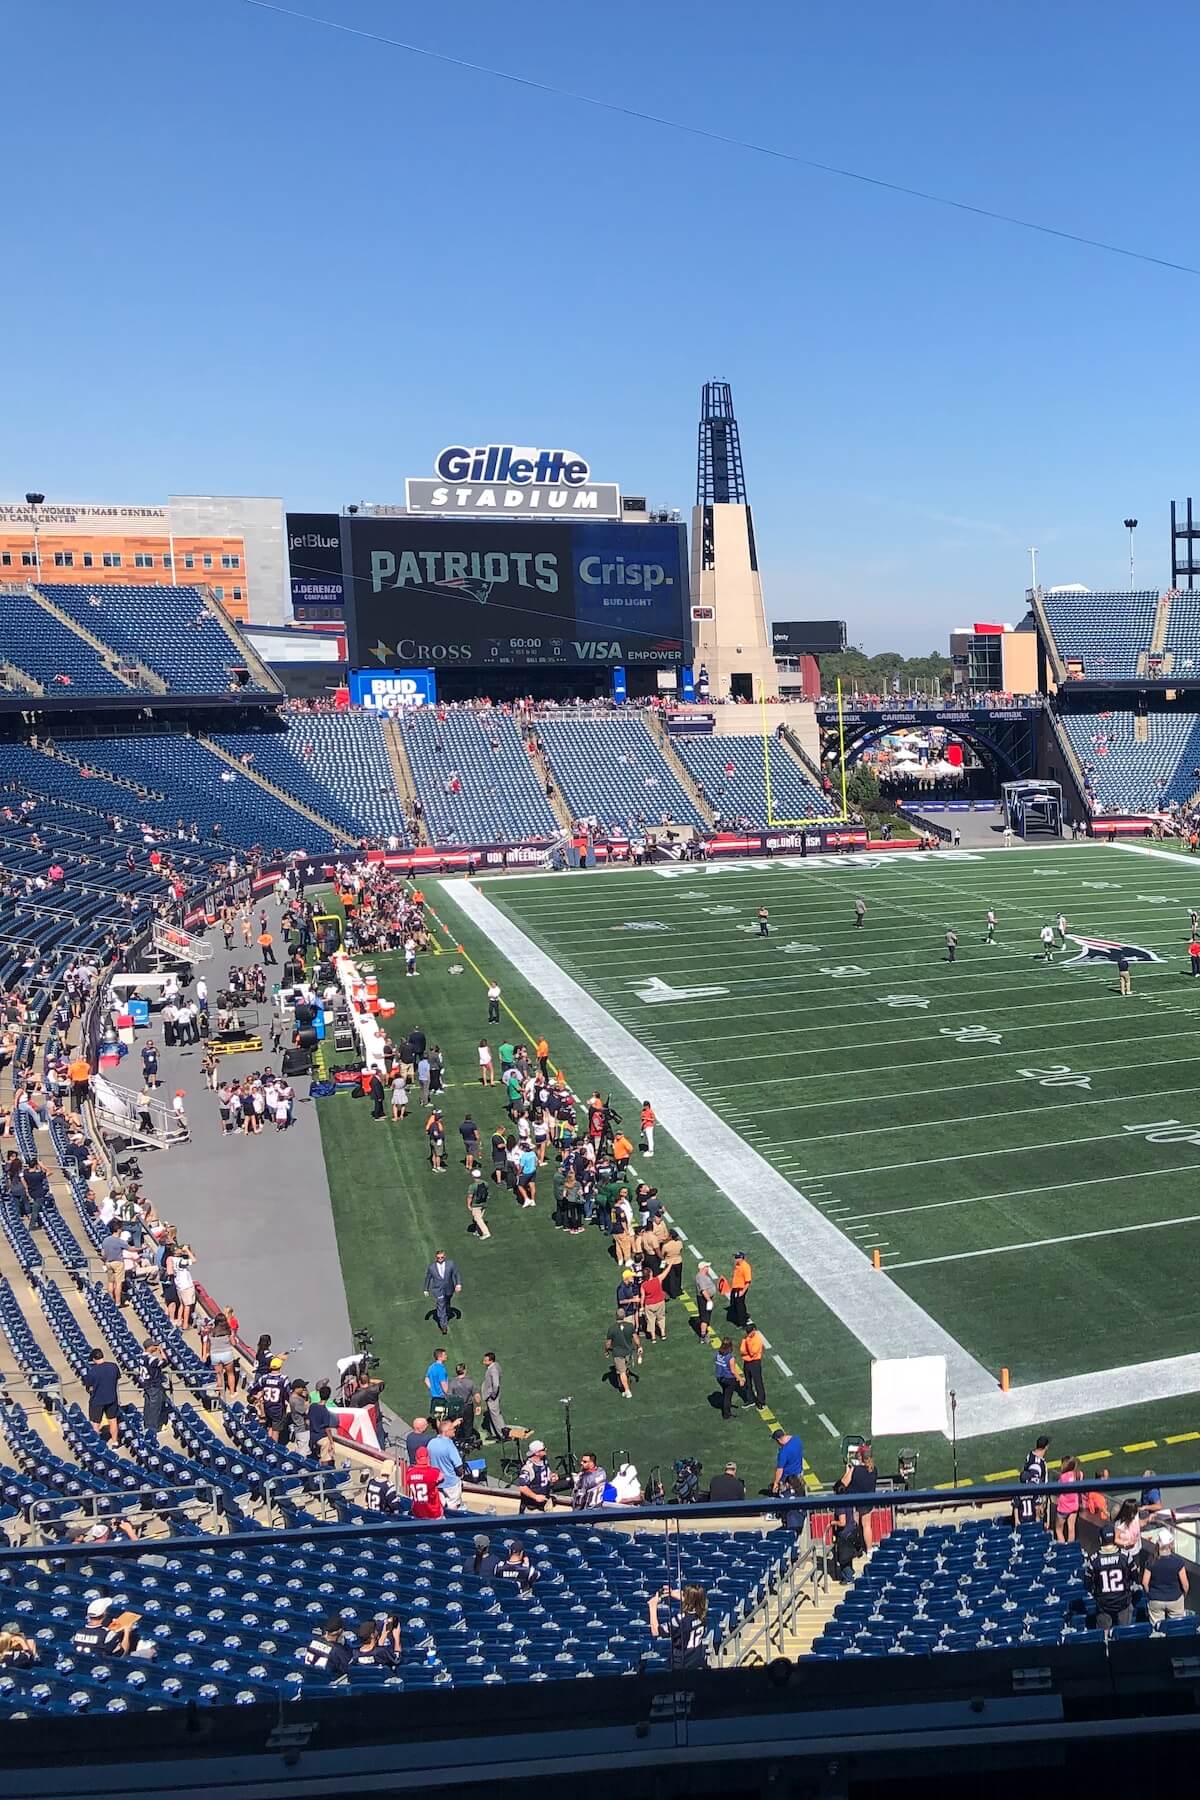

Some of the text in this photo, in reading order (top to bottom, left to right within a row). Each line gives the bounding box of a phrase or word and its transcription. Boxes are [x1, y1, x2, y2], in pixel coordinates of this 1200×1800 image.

[437, 446, 589, 485] Gillette
[431, 488, 597, 509] STADIUM
[39, 515, 76, 523] CENTER
[121, 509, 165, 517] GENERAL
[290, 533, 339, 550] jetBlue
[370, 550, 559, 593] PATRIOTS
[579, 556, 674, 591] Crisp.
[293, 584, 342, 594] J.DERENZO
[603, 598, 653, 606] BUD LIGHT
[510, 638, 541, 648] 60:00
[571, 641, 623, 659] VISA
[491, 647, 498, 656] 0
[553, 647, 561, 655] 0
[628, 651, 681, 660] EMPOWER
[371, 679, 417, 694] BUD
[363, 694, 426, 709] LIGHT
[653, 851, 986, 877] PATRIOTS
[819, 965, 871, 978] 50
[939, 1024, 1003, 1043] 30
[1015, 1065, 1092, 1087] 20
[263, 1387, 281, 1402] 33
[409, 1483, 428, 1502] 12
[367, 1492, 380, 1511] 12
[1022, 1501, 1033, 1516] 11
[1100, 1556, 1119, 1564] BRADY
[1100, 1569, 1124, 1593] 12
[687, 1626, 704, 1649] 12
